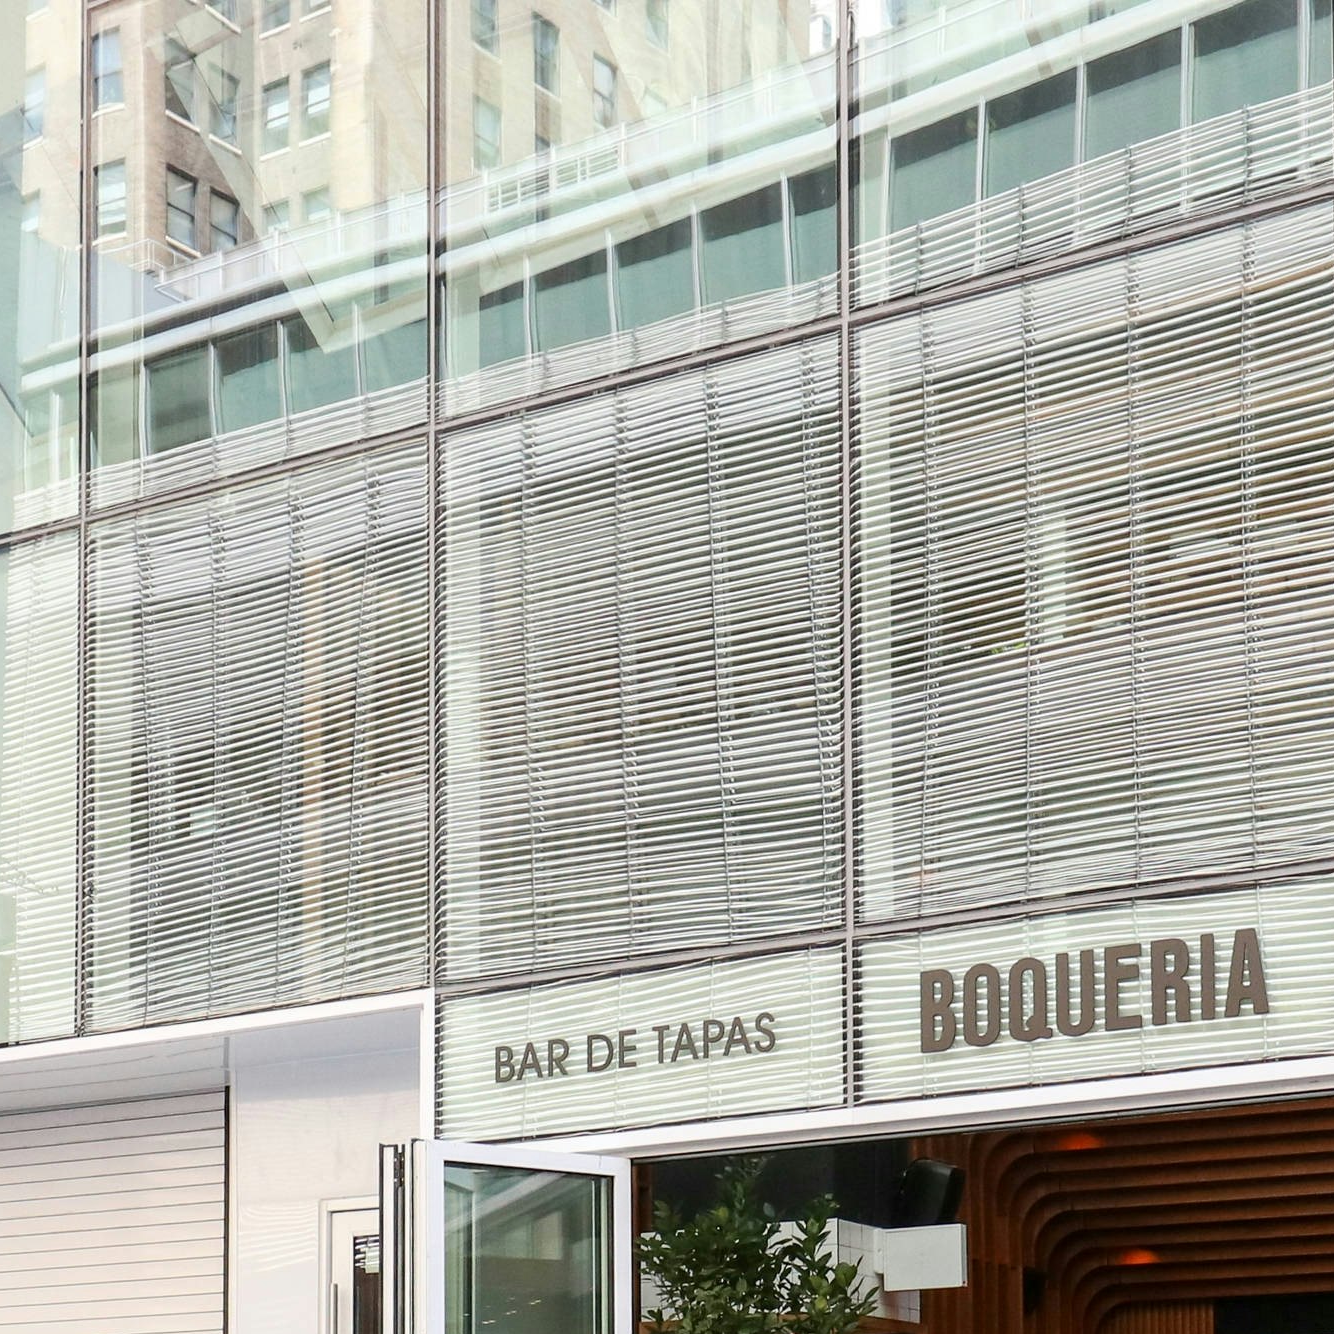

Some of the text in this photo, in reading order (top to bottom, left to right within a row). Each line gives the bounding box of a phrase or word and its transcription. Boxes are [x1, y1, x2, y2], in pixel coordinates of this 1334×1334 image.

[919, 927, 1270, 1054] BOQUERIA
[494, 1012, 778, 1085] BAR DE TAPAS
